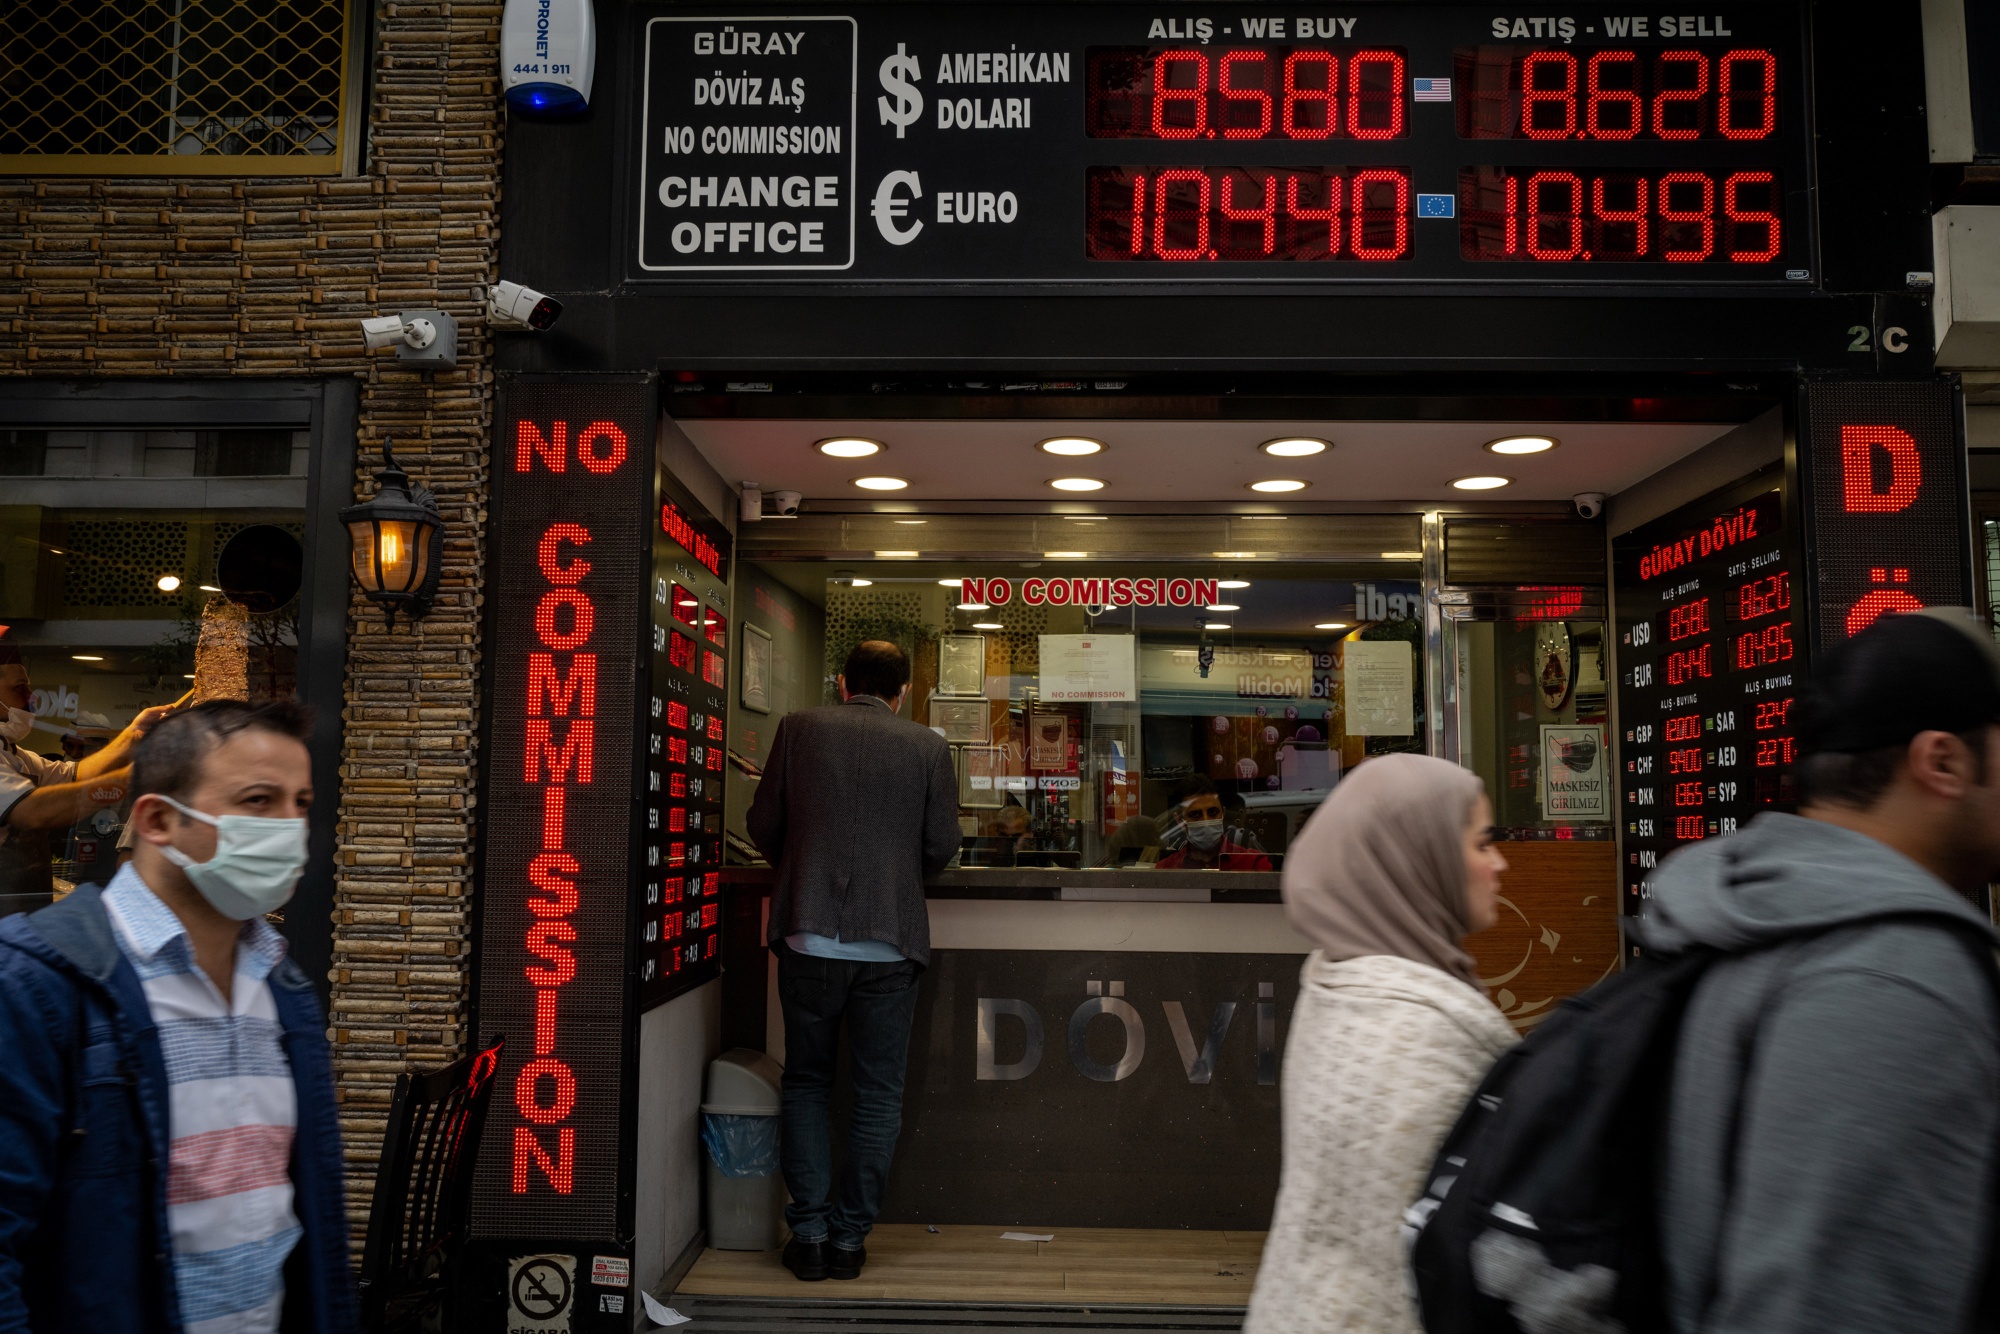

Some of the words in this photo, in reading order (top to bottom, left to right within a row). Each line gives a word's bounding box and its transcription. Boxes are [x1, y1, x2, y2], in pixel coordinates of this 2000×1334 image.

[536, 0, 550, 59] PRONET
[694, 26, 805, 55] GÜRAY
[1148, 18, 1213, 44] ALIŞ
[1241, 18, 1286, 38] WE
[1296, 18, 1357, 38] BUY
[1491, 16, 1576, 43] SATIŞ
[1604, 16, 1649, 38] WE
[1659, 16, 1731, 38] SELL
[513, 64, 539, 74] 444
[543, 65, 548, 73] 1
[552, 65, 570, 74] 911
[936, 43, 1071, 83] AMERİKAN
[694, 69, 762, 107] DÖVİZ
[769, 77, 805, 113] A.Ş
[1152, 51, 1404, 140] 8.580
[1522, 50, 1776, 140] 8.620
[937, 98, 1032, 130] DOLARI
[664, 126, 696, 154] NO
[701, 126, 841, 154] COMMISSION
[658, 176, 839, 208] CHANGE
[937, 191, 1018, 224] EURO
[1131, 170, 1407, 261] 10.440
[1505, 171, 1781, 263] 10.495
[671, 221, 825, 254] OFFICE
[516, 421, 627, 474] NO
[662, 504, 694, 553] GÜRAY
[695, 534, 720, 576] DÖVİZ
[1640, 536, 1695, 580] GÜRAY
[1700, 508, 1758, 557] DÖVİZ
[1751, 549, 1780, 570] SELLING
[961, 577, 1012, 606] NO
[1022, 577, 1219, 607] COMISSION
[1678, 579, 1700, 596] BUYING
[1632, 621, 1650, 647] USD
[1634, 663, 1652, 688] EUR
[1765, 674, 1792, 690] BUYING
[1051, 691, 1064, 699] NO
[1067, 691, 1126, 699] COMMISSION
[1636, 725, 1652, 743] GBP
[1716, 711, 1735, 733] SAR
[1637, 755, 1653, 774] CHF
[1718, 746, 1736, 767] AED
[1549, 779, 1600, 792] MASKESİZ
[1638, 787, 1654, 805] DKK
[1719, 782, 1737, 802] SYP
[1551, 796, 1600, 809] GİRİLMEZ
[1639, 819, 1654, 837] SEK
[513, 523, 597, 1194] COMMISSION
[1640, 850, 1657, 868] NOK
